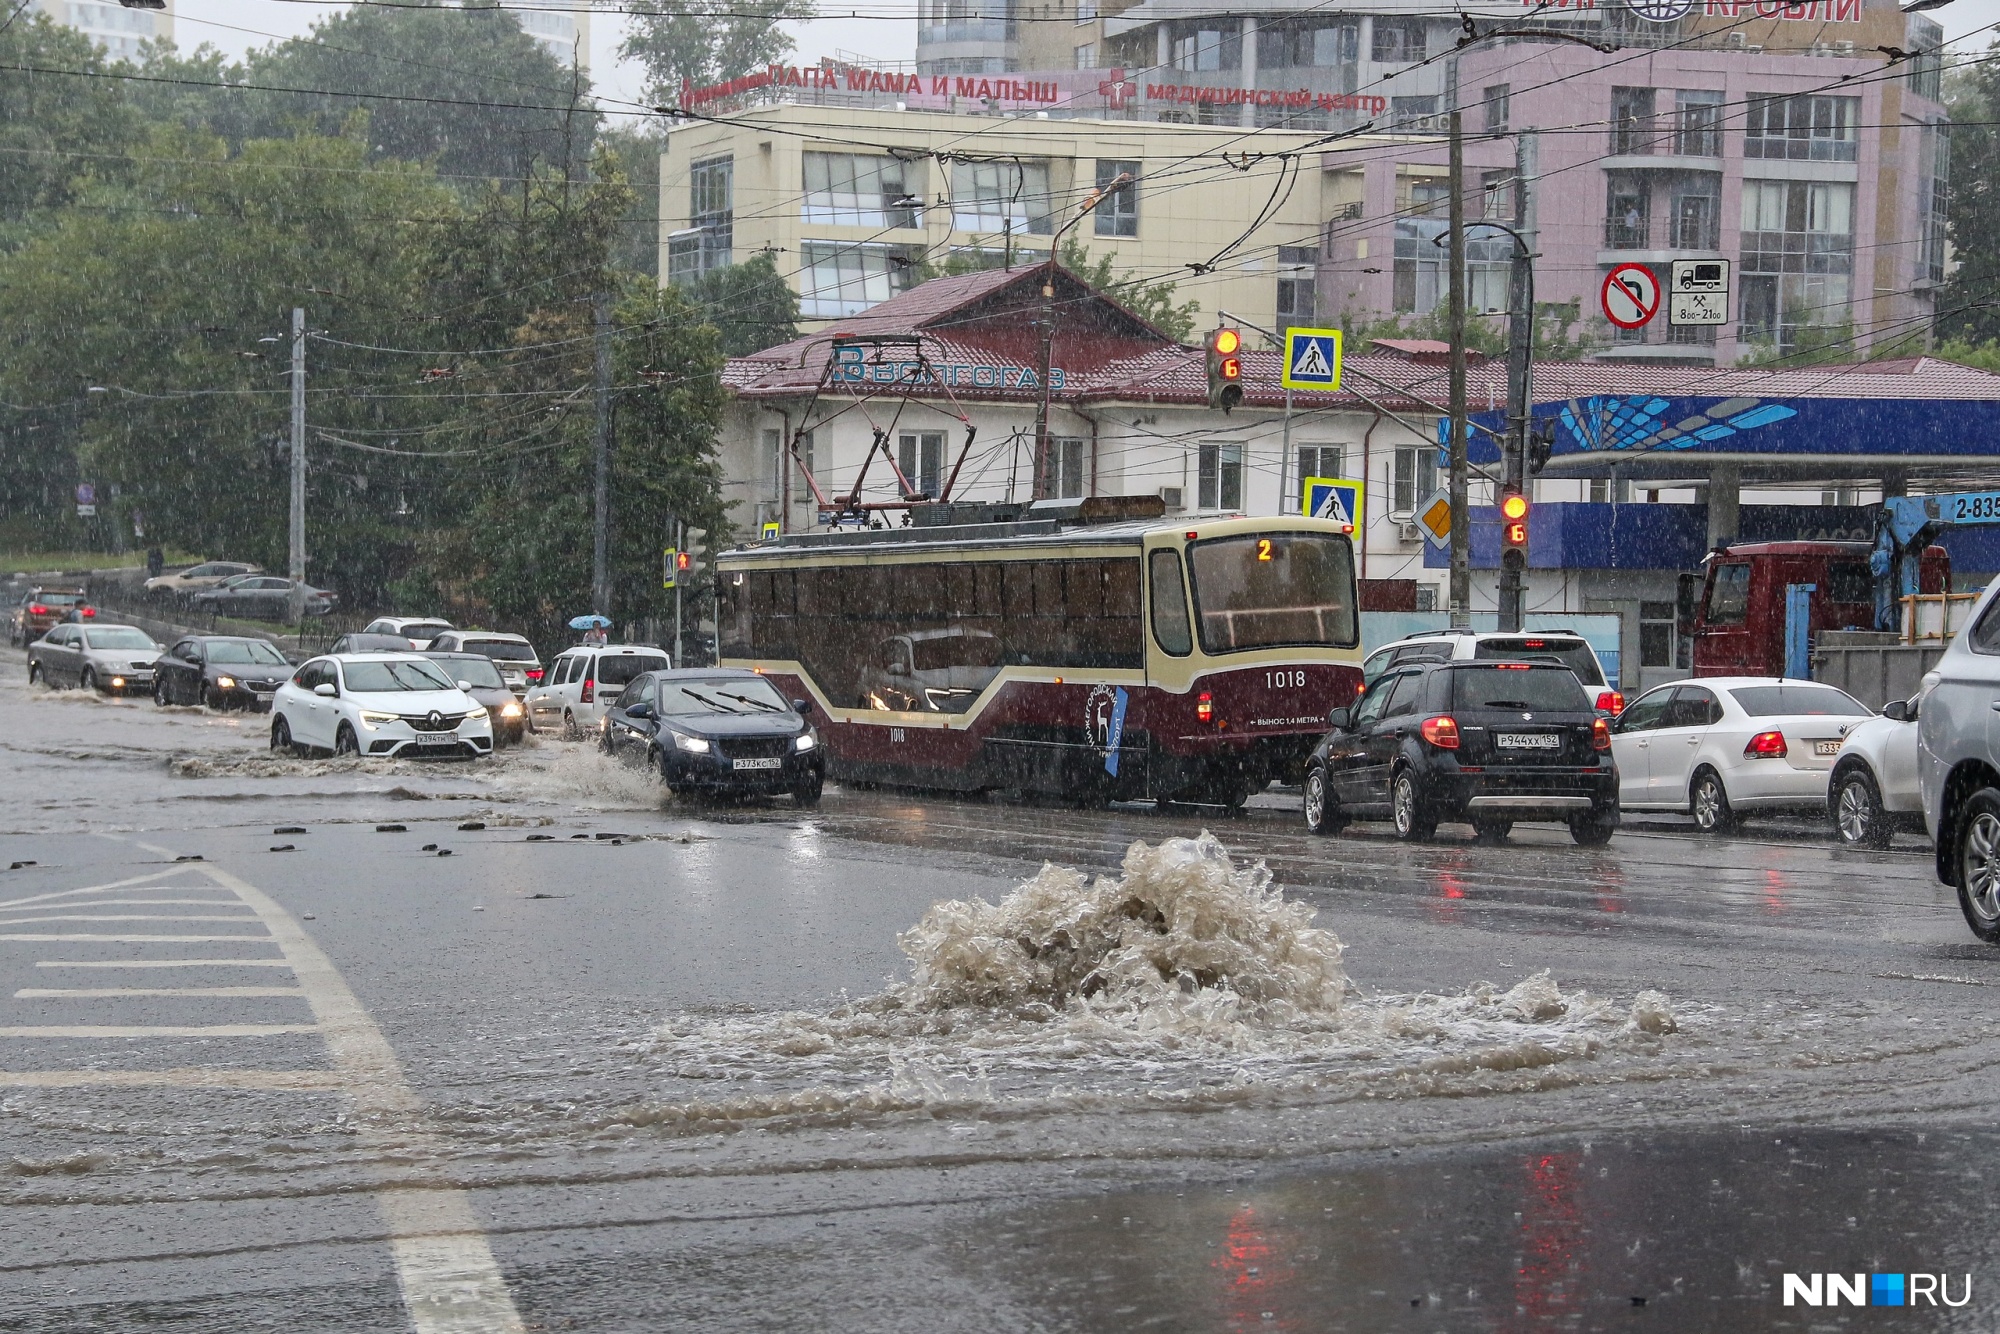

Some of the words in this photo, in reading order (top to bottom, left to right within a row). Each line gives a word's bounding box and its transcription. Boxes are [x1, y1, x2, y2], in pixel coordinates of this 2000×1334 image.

[768, 64, 838, 90] ПАПА
[847, 70, 923, 95] МАМА
[932, 75, 948, 97] И
[956, 76, 1058, 103] МАЛЫШ
[1146, 83, 1312, 108] медицинский
[1317, 92, 1386, 116] центр
[1225, 359, 1238, 377] 16
[1956, 496, 2000, 519] 2-835
[1511, 524, 1524, 541] 16
[1258, 539, 1272, 561] 2
[1265, 670, 1306, 689] 1018
[1257, 717, 1285, 726] ВЫНОС
[1296, 716, 1319, 724] МЕТРА
[890, 728, 905, 742] 1018
[1541, 734, 1557, 744] 152
